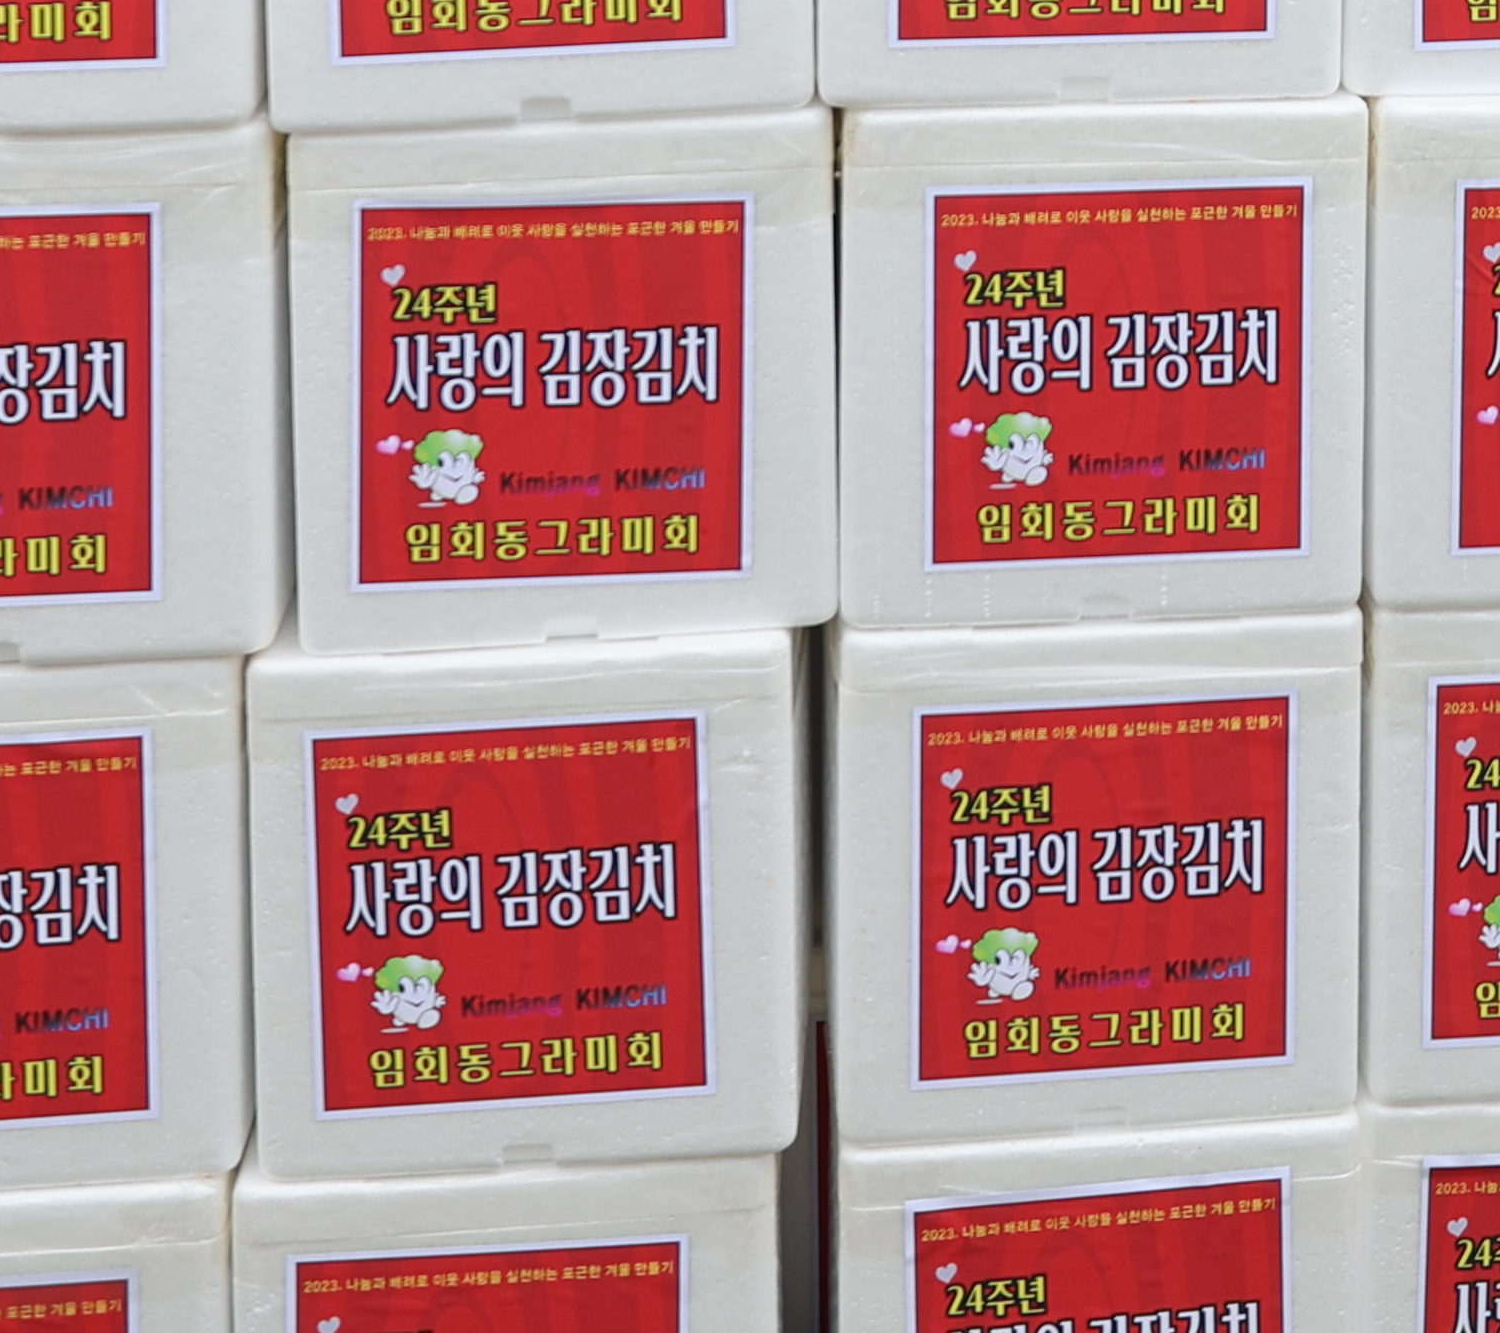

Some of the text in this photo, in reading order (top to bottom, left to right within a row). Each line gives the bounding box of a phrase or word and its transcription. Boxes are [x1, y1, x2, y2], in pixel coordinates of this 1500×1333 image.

[348, 808, 452, 850] 24주년
[345, 842, 676, 937] 사랑의 김장김치
[369, 1031, 663, 1089] 임회동그라미회
